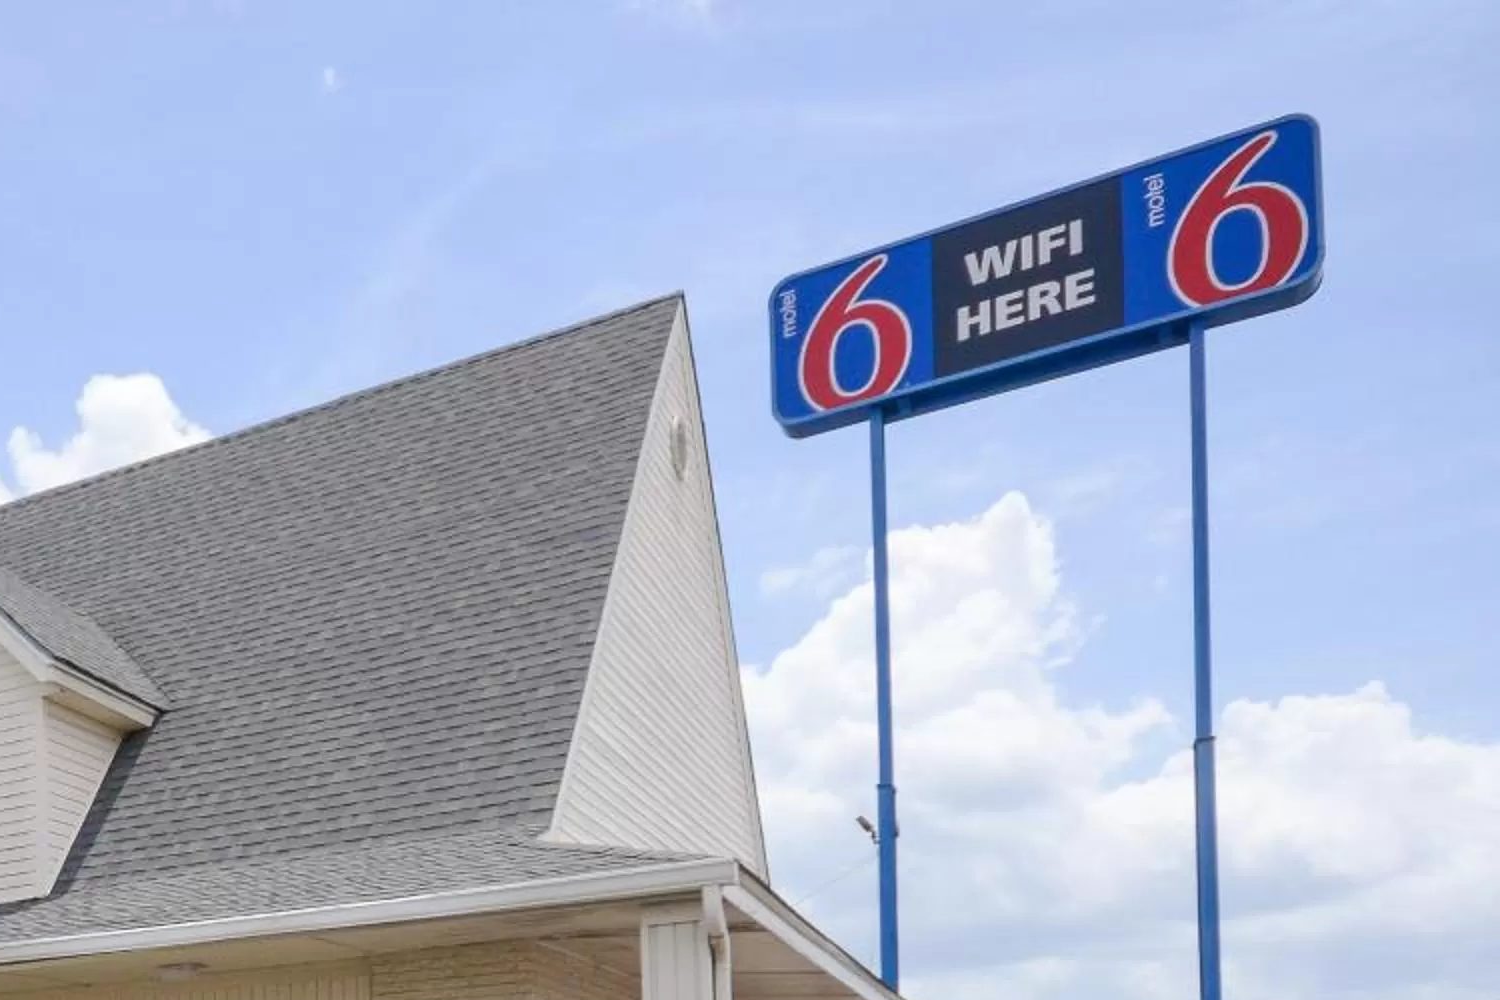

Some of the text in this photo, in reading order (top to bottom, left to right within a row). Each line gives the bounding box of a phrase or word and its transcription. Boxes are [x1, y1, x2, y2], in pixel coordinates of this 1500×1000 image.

[963, 218, 1084, 287] WIFI
[1143, 130, 1309, 309] motel 6
[779, 253, 913, 412] motel 6
[956, 267, 1097, 343] HERE
